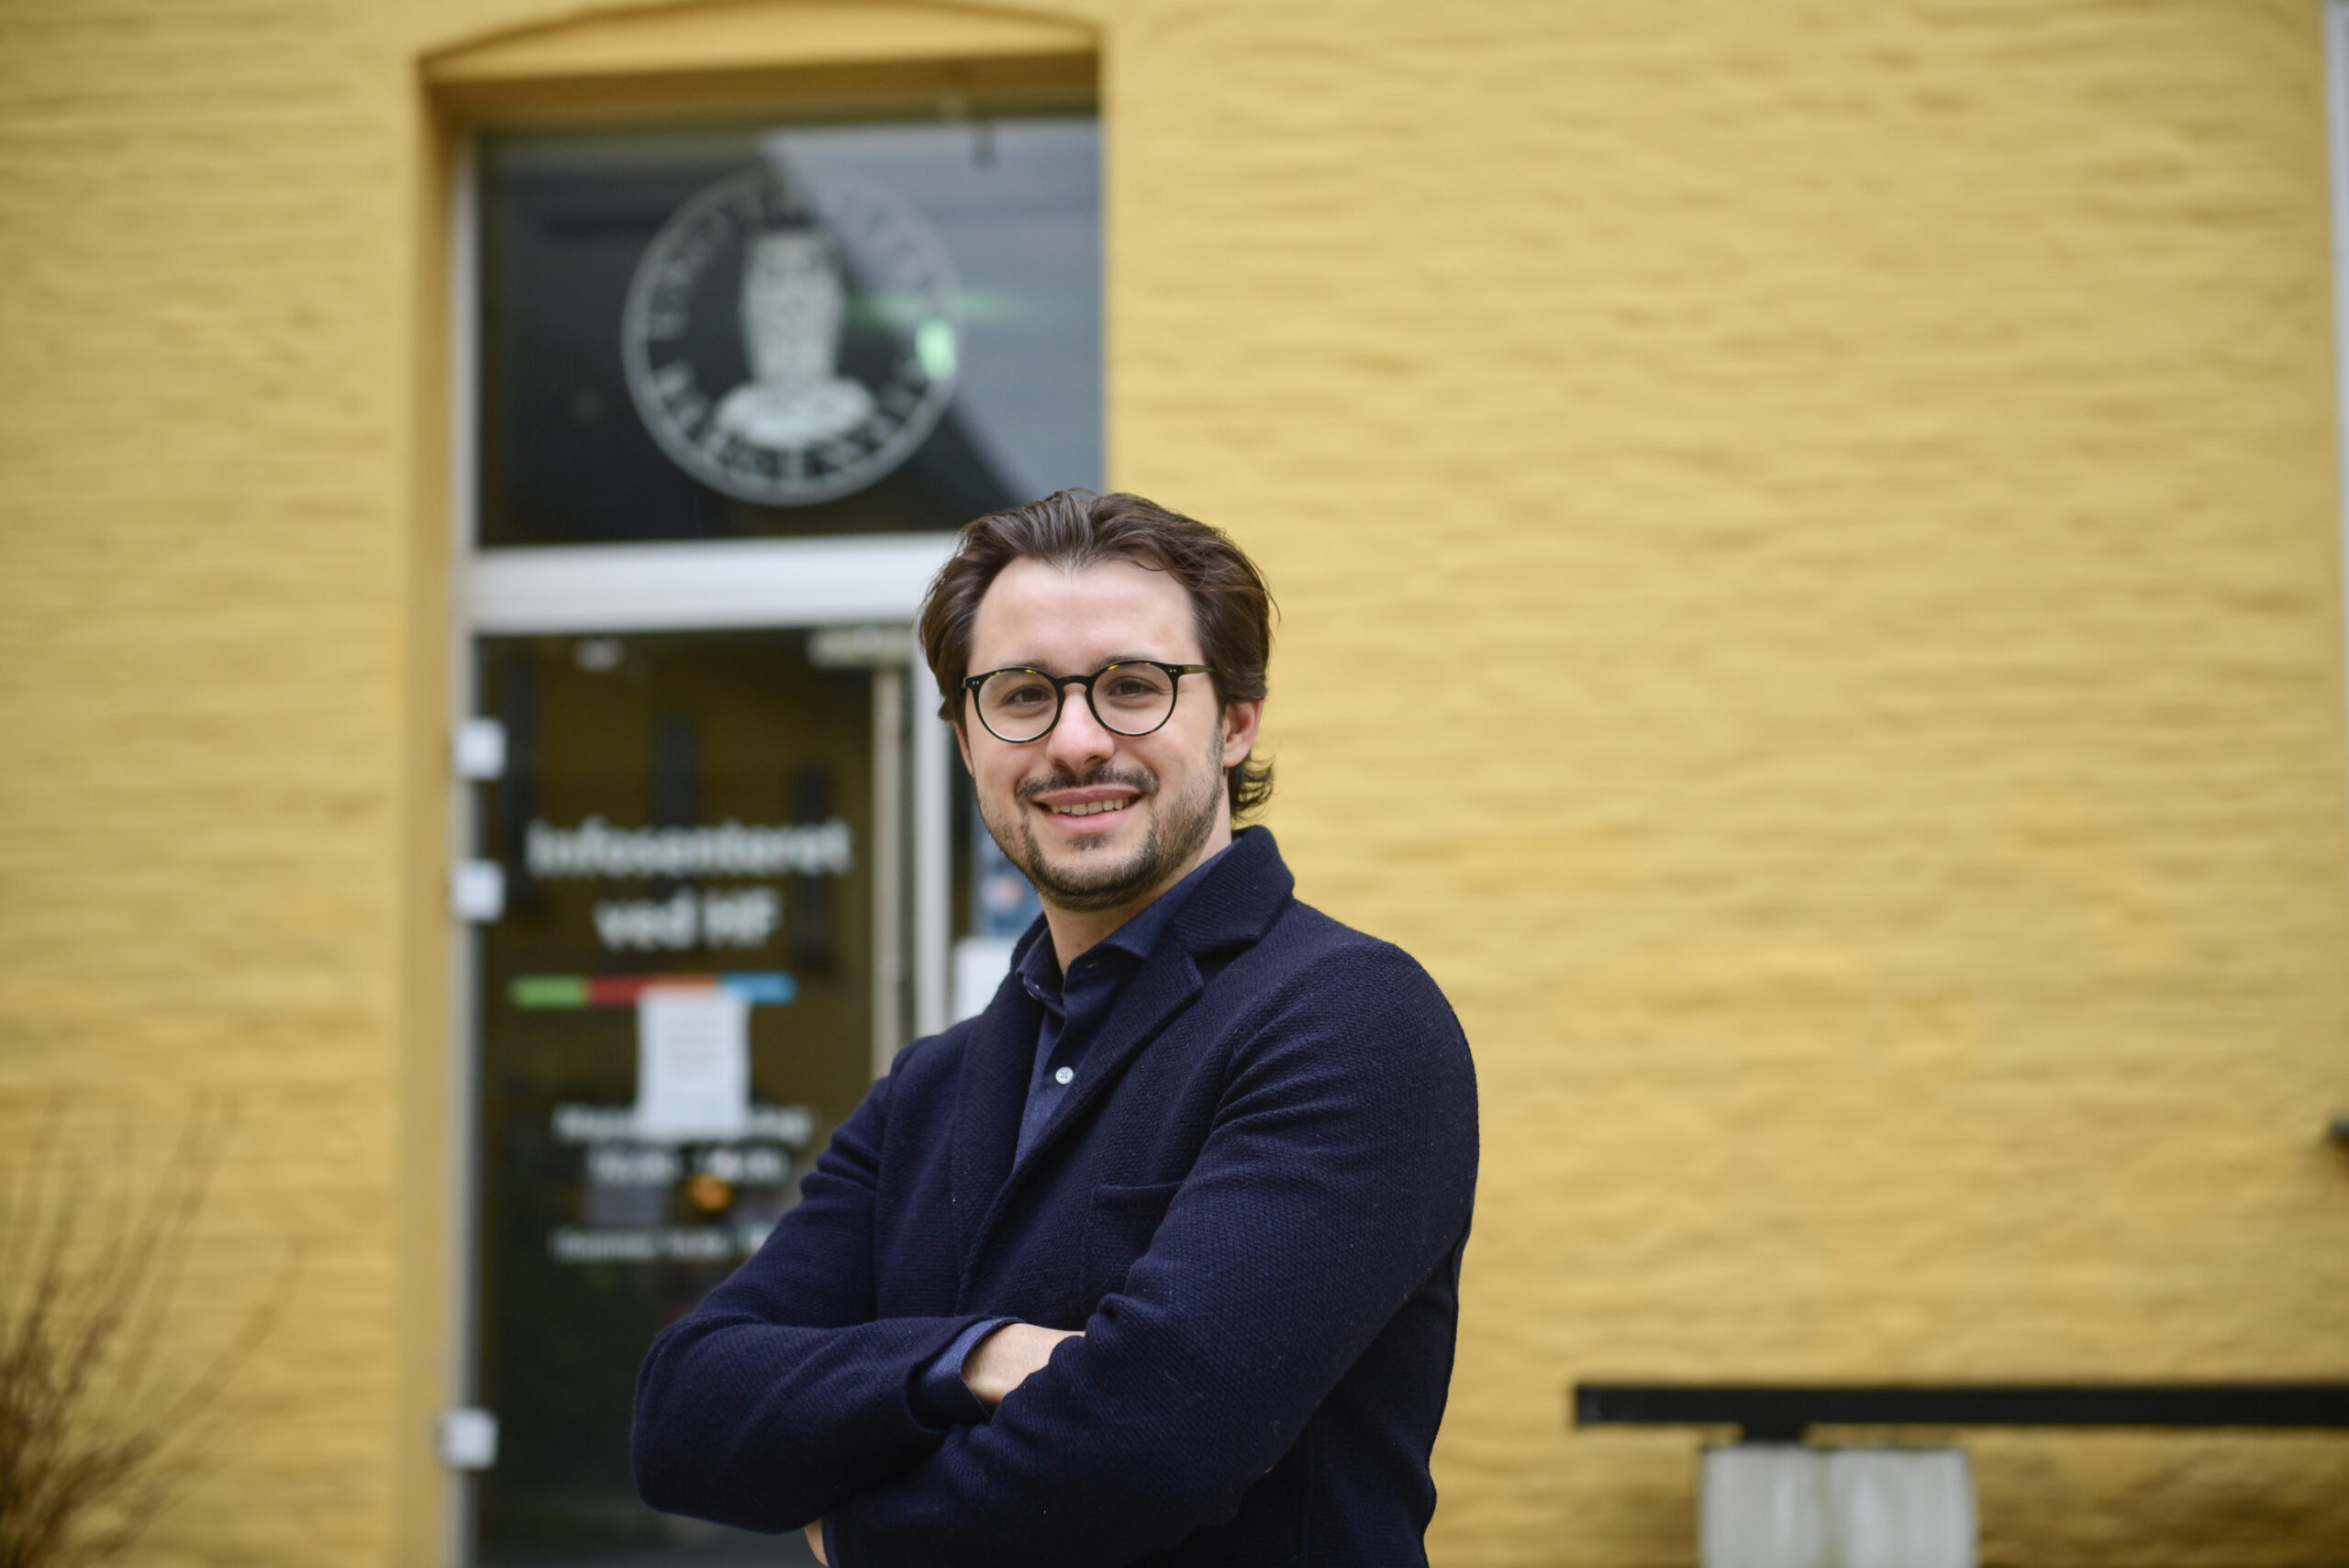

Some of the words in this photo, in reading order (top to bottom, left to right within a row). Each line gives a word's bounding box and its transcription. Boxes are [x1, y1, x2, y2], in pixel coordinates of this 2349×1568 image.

[529, 818, 850, 873] Infosenteret
[597, 892, 694, 946] ved
[705, 891, 778, 944] HF
